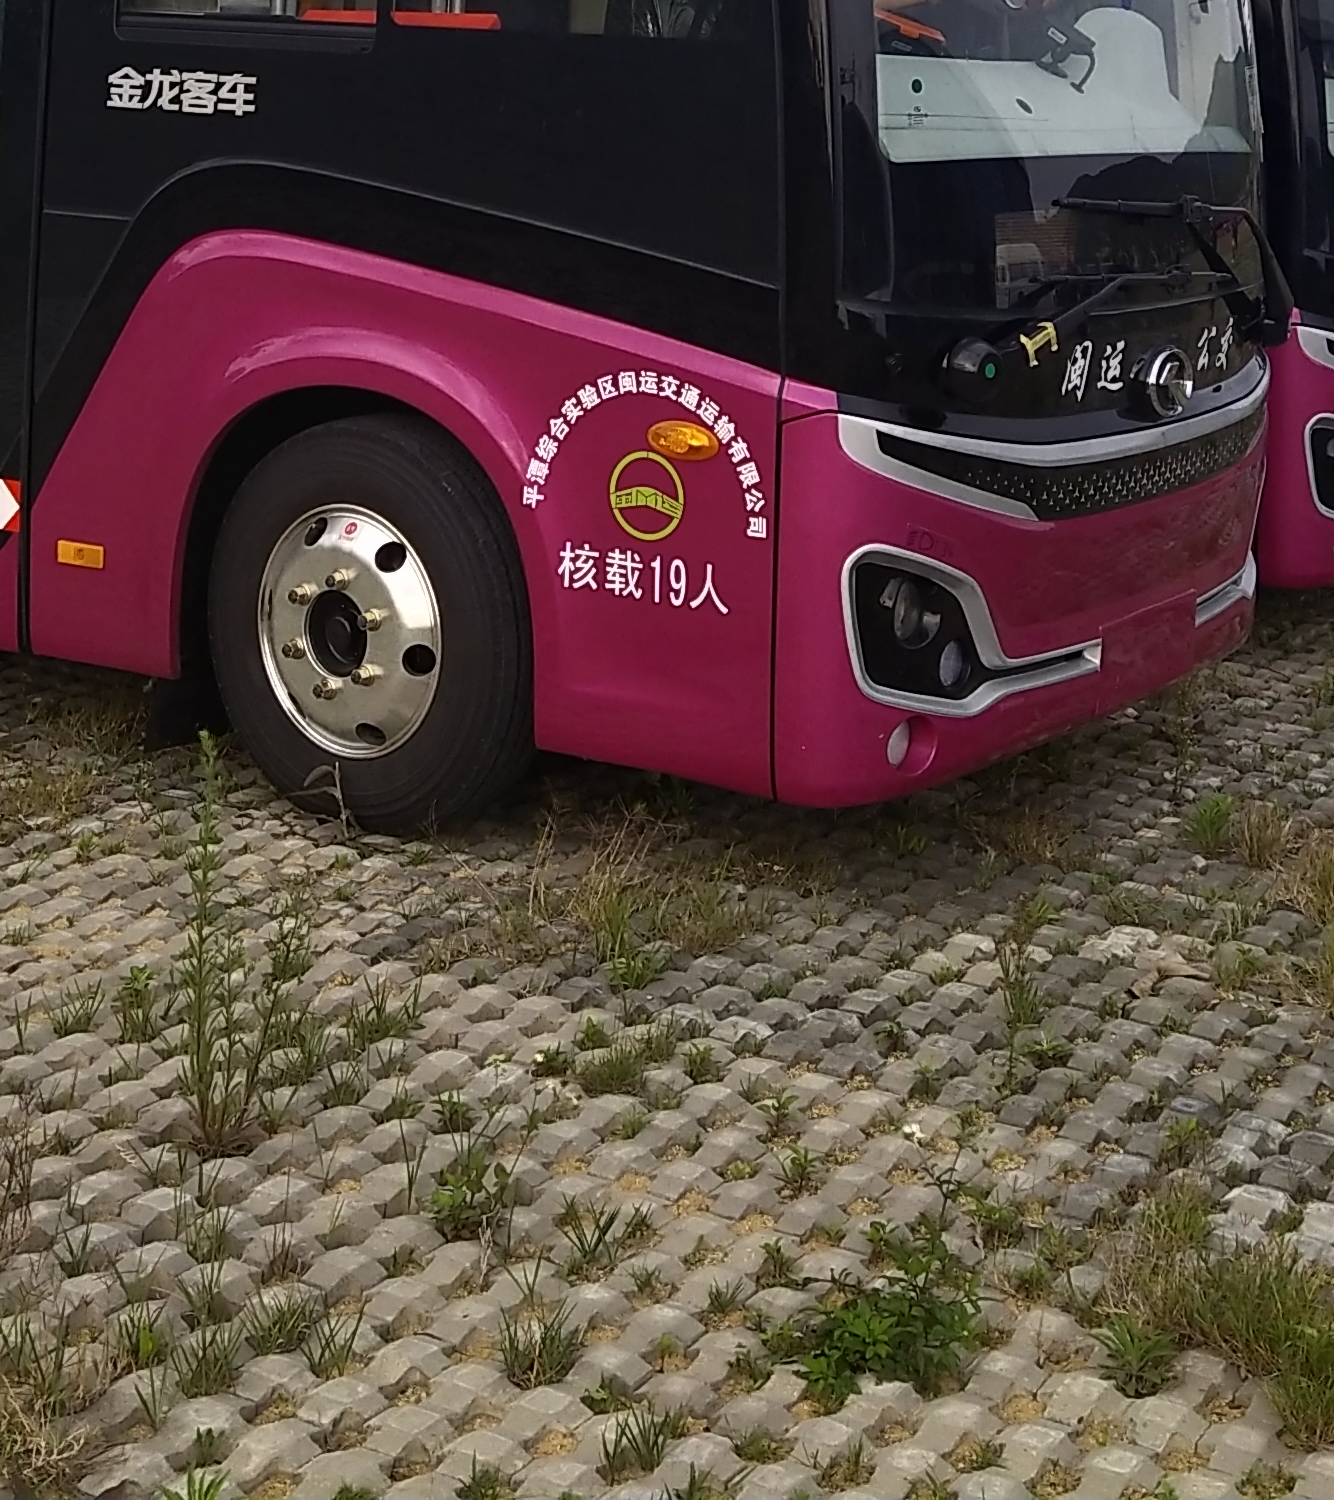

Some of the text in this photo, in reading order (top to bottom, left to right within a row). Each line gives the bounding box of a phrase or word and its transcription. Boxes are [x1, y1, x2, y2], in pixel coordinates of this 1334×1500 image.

[106, 66, 257, 116] 金龙客车
[1061, 340, 1126, 402] 闽运
[523, 371, 767, 538] 平潭综合实验区闽运交通运输有限公司
[558, 542, 729, 615] 核载19人
